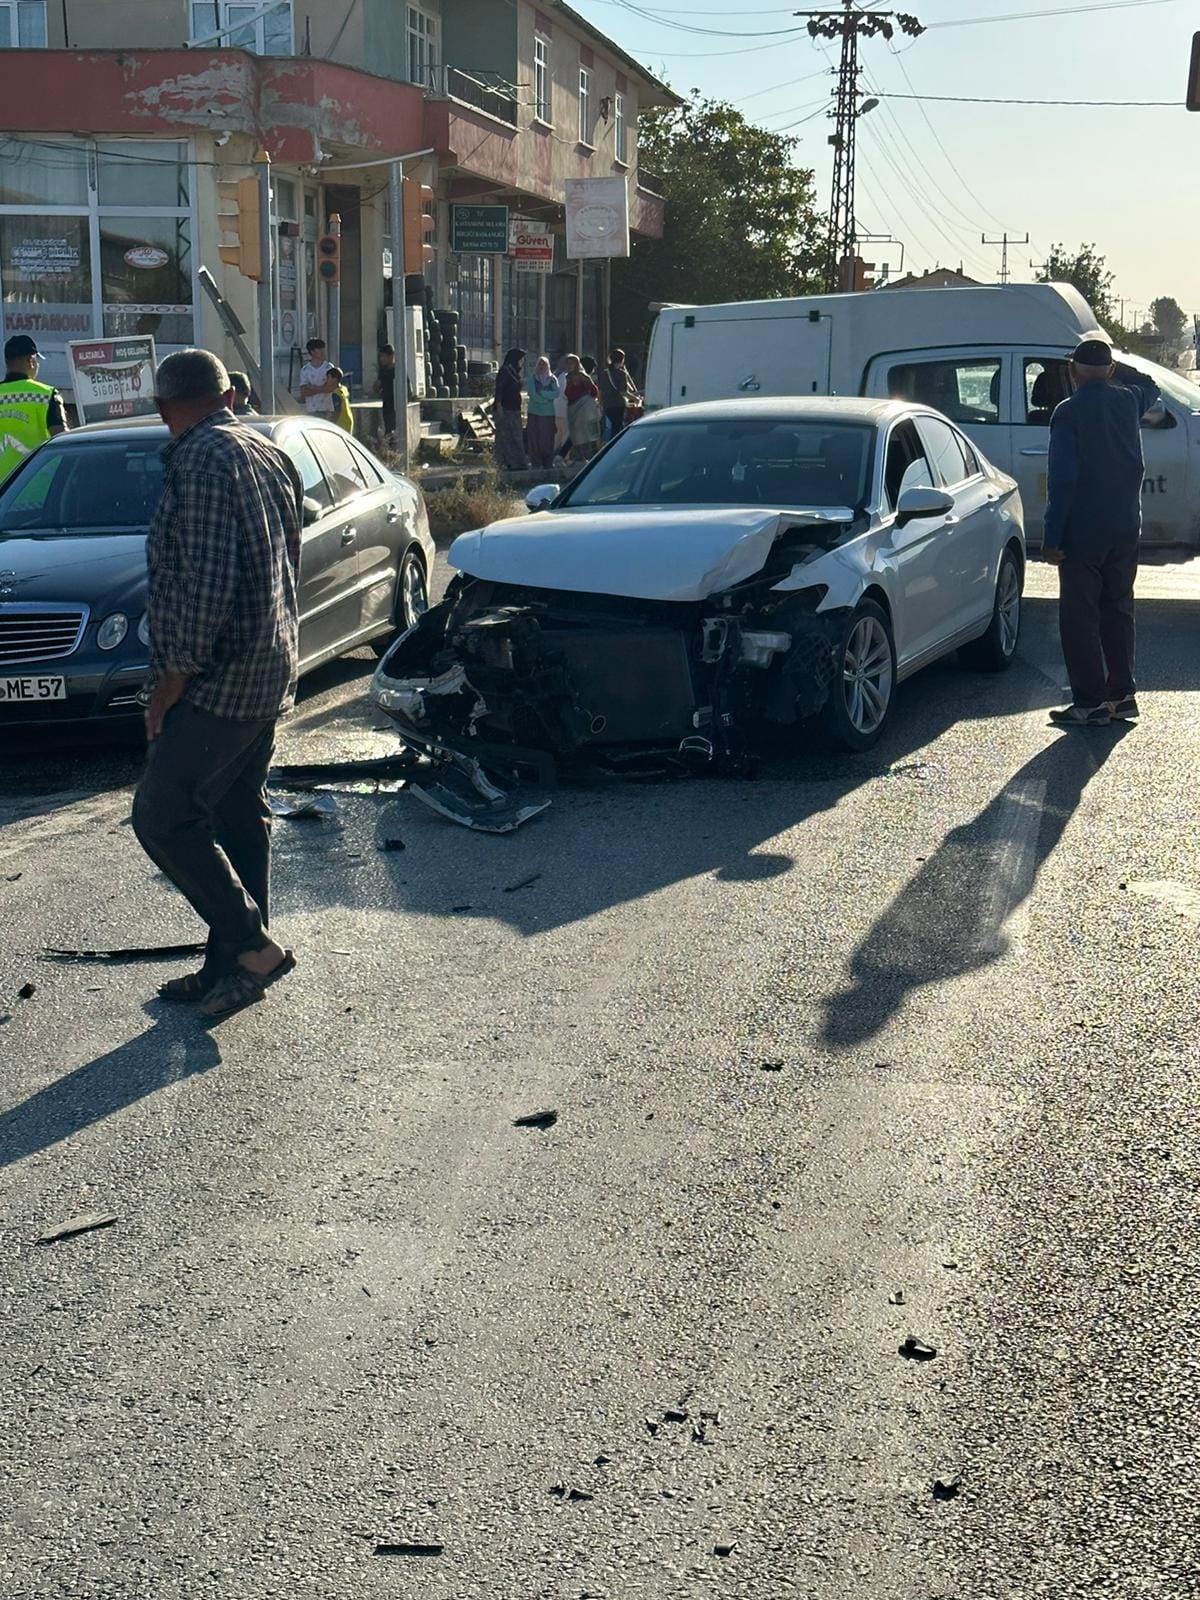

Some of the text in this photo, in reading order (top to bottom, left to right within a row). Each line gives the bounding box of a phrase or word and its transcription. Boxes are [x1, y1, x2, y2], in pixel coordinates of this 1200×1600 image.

[516, 234, 550, 248] Güven
[5, 313, 91, 331] KASTAMONU
[6, 678, 63, 699] ME 57
